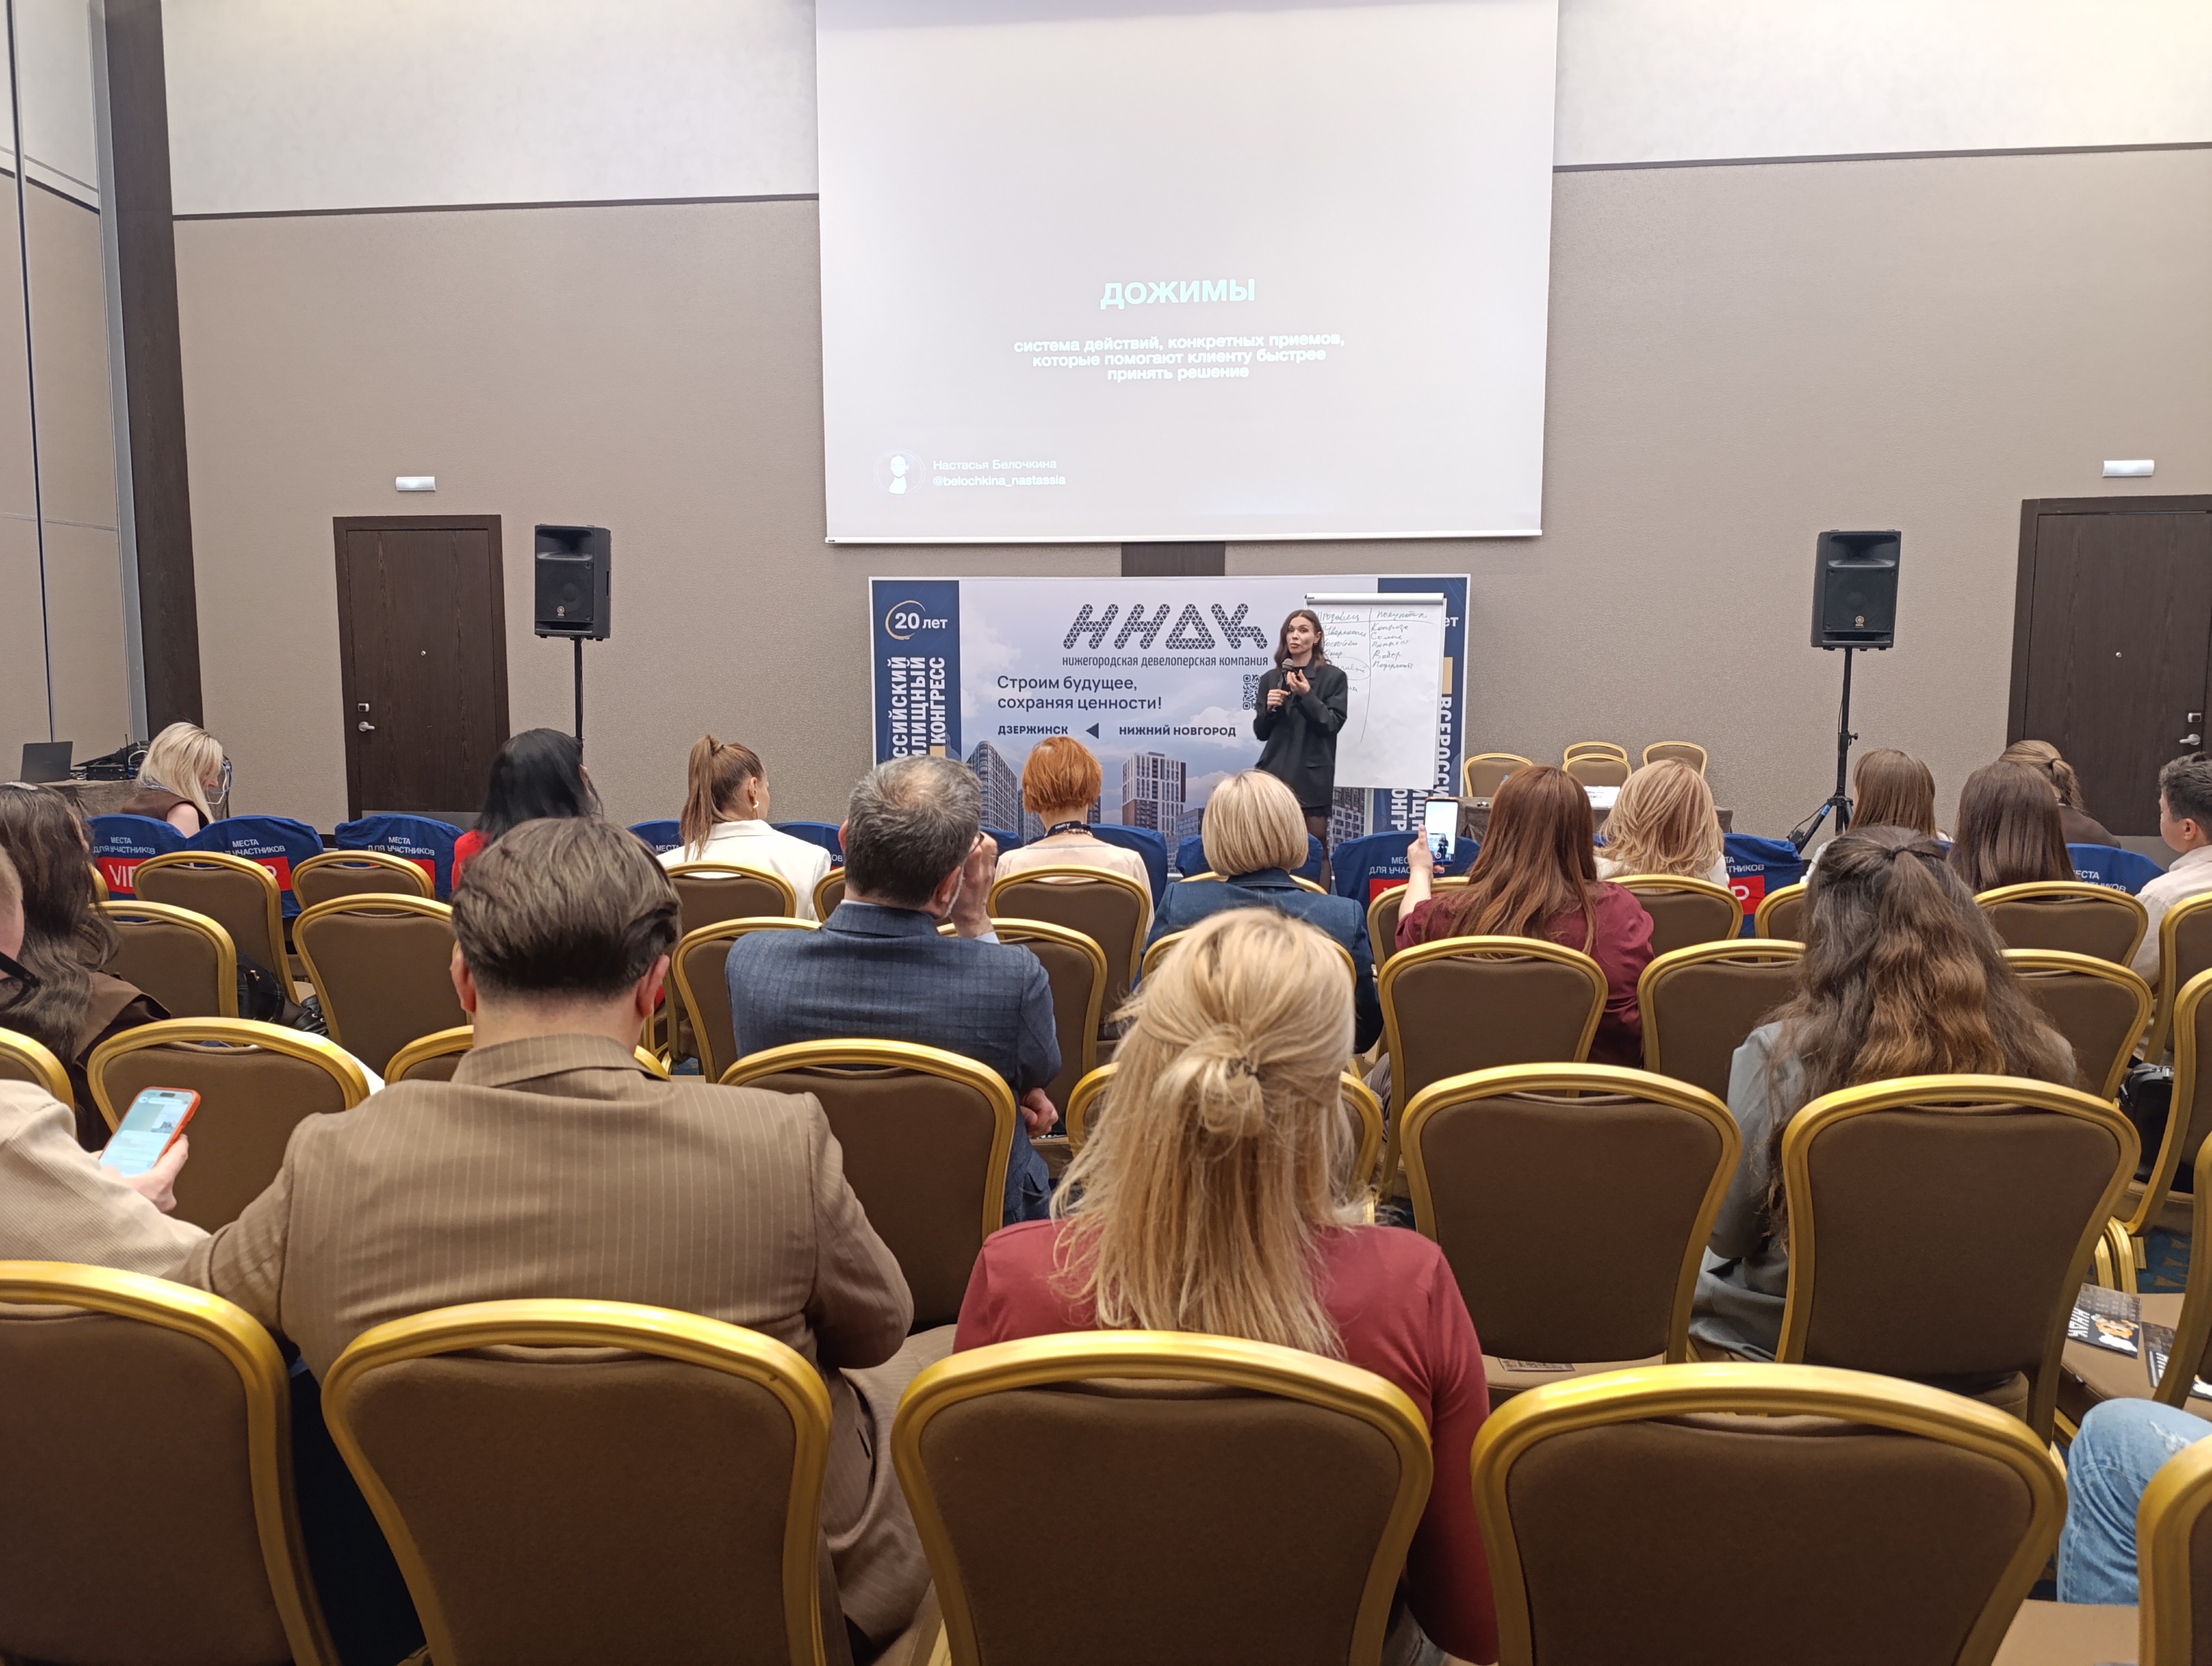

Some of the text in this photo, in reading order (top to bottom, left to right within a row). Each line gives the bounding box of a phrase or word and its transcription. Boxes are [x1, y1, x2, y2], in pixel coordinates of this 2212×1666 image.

[1100, 279, 1255, 310] ДОЖИМЫ
[1014, 334, 1345, 353] система действий, конкретных приемов,
[1033, 348, 1326, 369] которые помогают клиенту быстрее
[1108, 367, 1250, 383] принять решение
[933, 459, 1057, 470] Настасья Белочкина
[933, 475, 1066, 487] @belochkina_nastassia
[895, 612, 948, 629] 20 лет
[1063, 604, 1268, 649] ННДК
[1445, 617, 1459, 627] ет
[1062, 656, 1268, 669] нижегородская девелоперская компания
[997, 675, 1137, 693] Строим будущее,
[906, 657, 928, 755] ЛИЩНЫЙ
[929, 657, 946, 744] КОНГРЕСС
[998, 696, 1162, 712] сохраняя ценности!
[888, 657, 908, 758] ССИЙСКИЙ
[998, 726, 1068, 735] ДЗЕРЖИНСК
[1119, 724, 1236, 737] НИЖНИЙ НОВГОРОД
[232, 839, 259, 847] МЕСТА
[388, 836, 410, 845] МЕСТА
[93, 845, 156, 855] ДЛЯ УЧАСТНИКОВ
[232, 845, 286, 856] УЧАСТНИКОВ
[387, 845, 435, 856] УЧАСТНИКОВ
[1369, 866, 1387, 876] ДЛЯ
[1726, 864, 1765, 873] ТНИКОВ
[2073, 870, 2100, 880] ЕСТА
